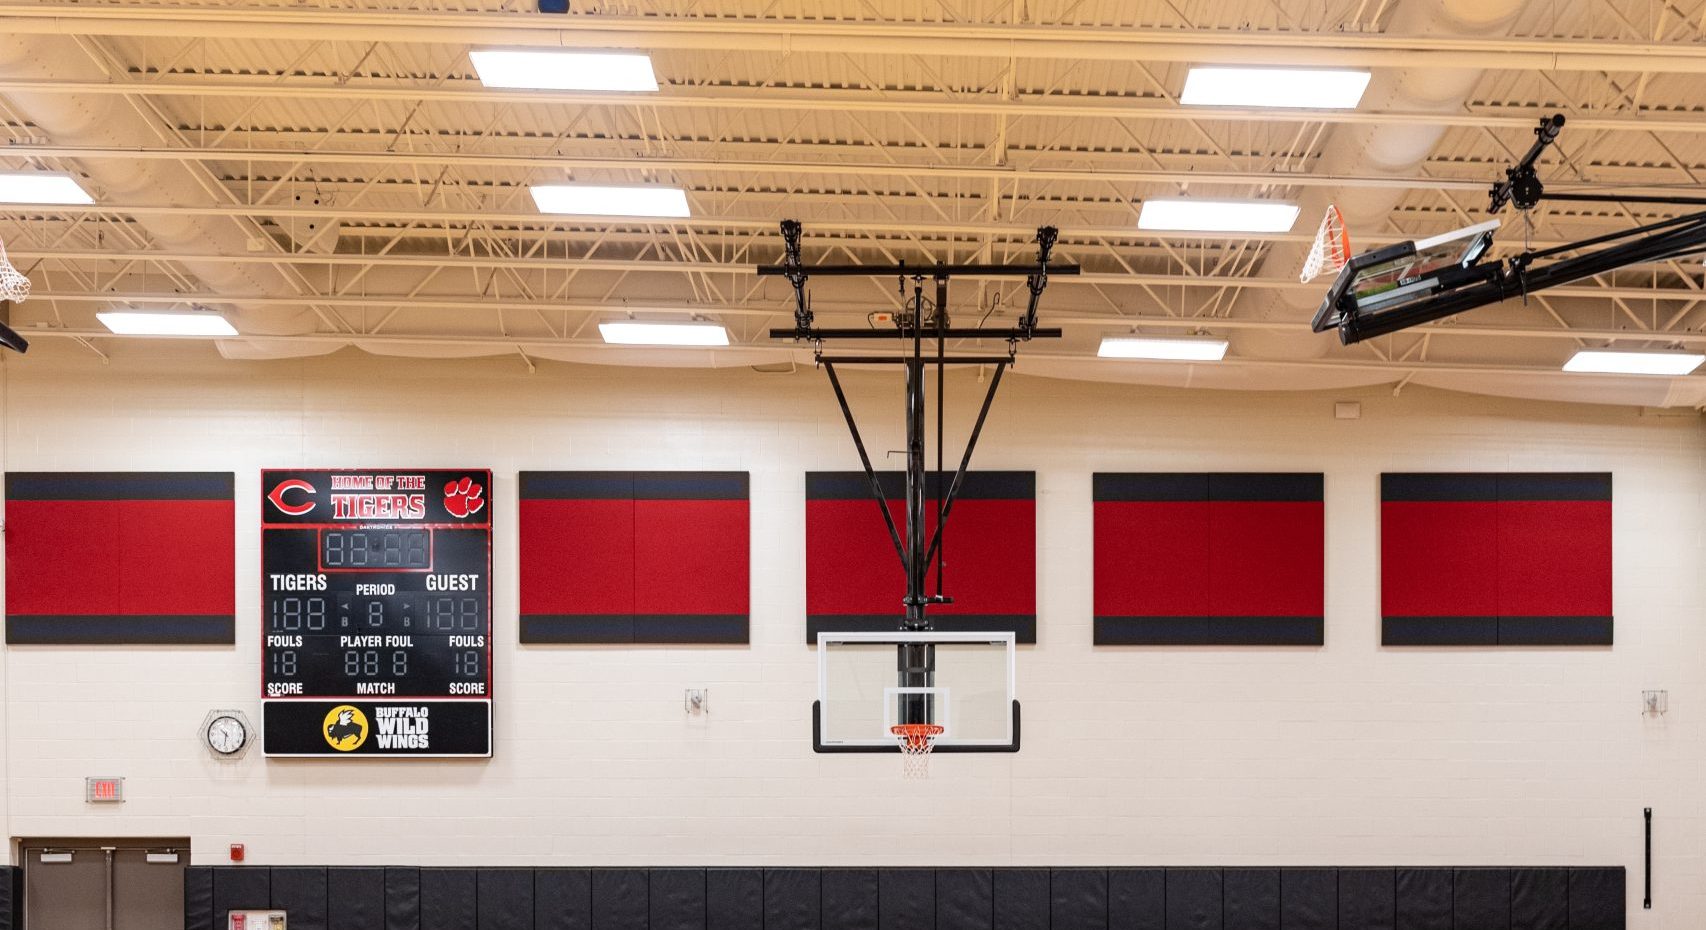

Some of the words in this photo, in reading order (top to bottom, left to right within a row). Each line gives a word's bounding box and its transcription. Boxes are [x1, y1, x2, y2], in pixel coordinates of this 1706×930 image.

[331, 475, 373, 490] HOME
[375, 475, 394, 490] OF
[396, 475, 426, 490] THE
[331, 494, 426, 520] TIGERS
[270, 574, 327, 591] TIGERS
[426, 574, 479, 591] GUEST
[356, 583, 396, 596] PERIOD
[267, 635, 303, 648] FOULS
[340, 635, 382, 648] PLAYER
[385, 635, 414, 648] FOUL
[449, 635, 485, 648] FOULS
[267, 682, 303, 695] SCORE
[356, 682, 396, 695] MATCH
[449, 682, 485, 695] SCORE
[375, 706, 429, 718] BUFFALO
[375, 718, 429, 734] WILD
[375, 734, 429, 749] WINGS
[95, 781, 115, 799] EXIT
